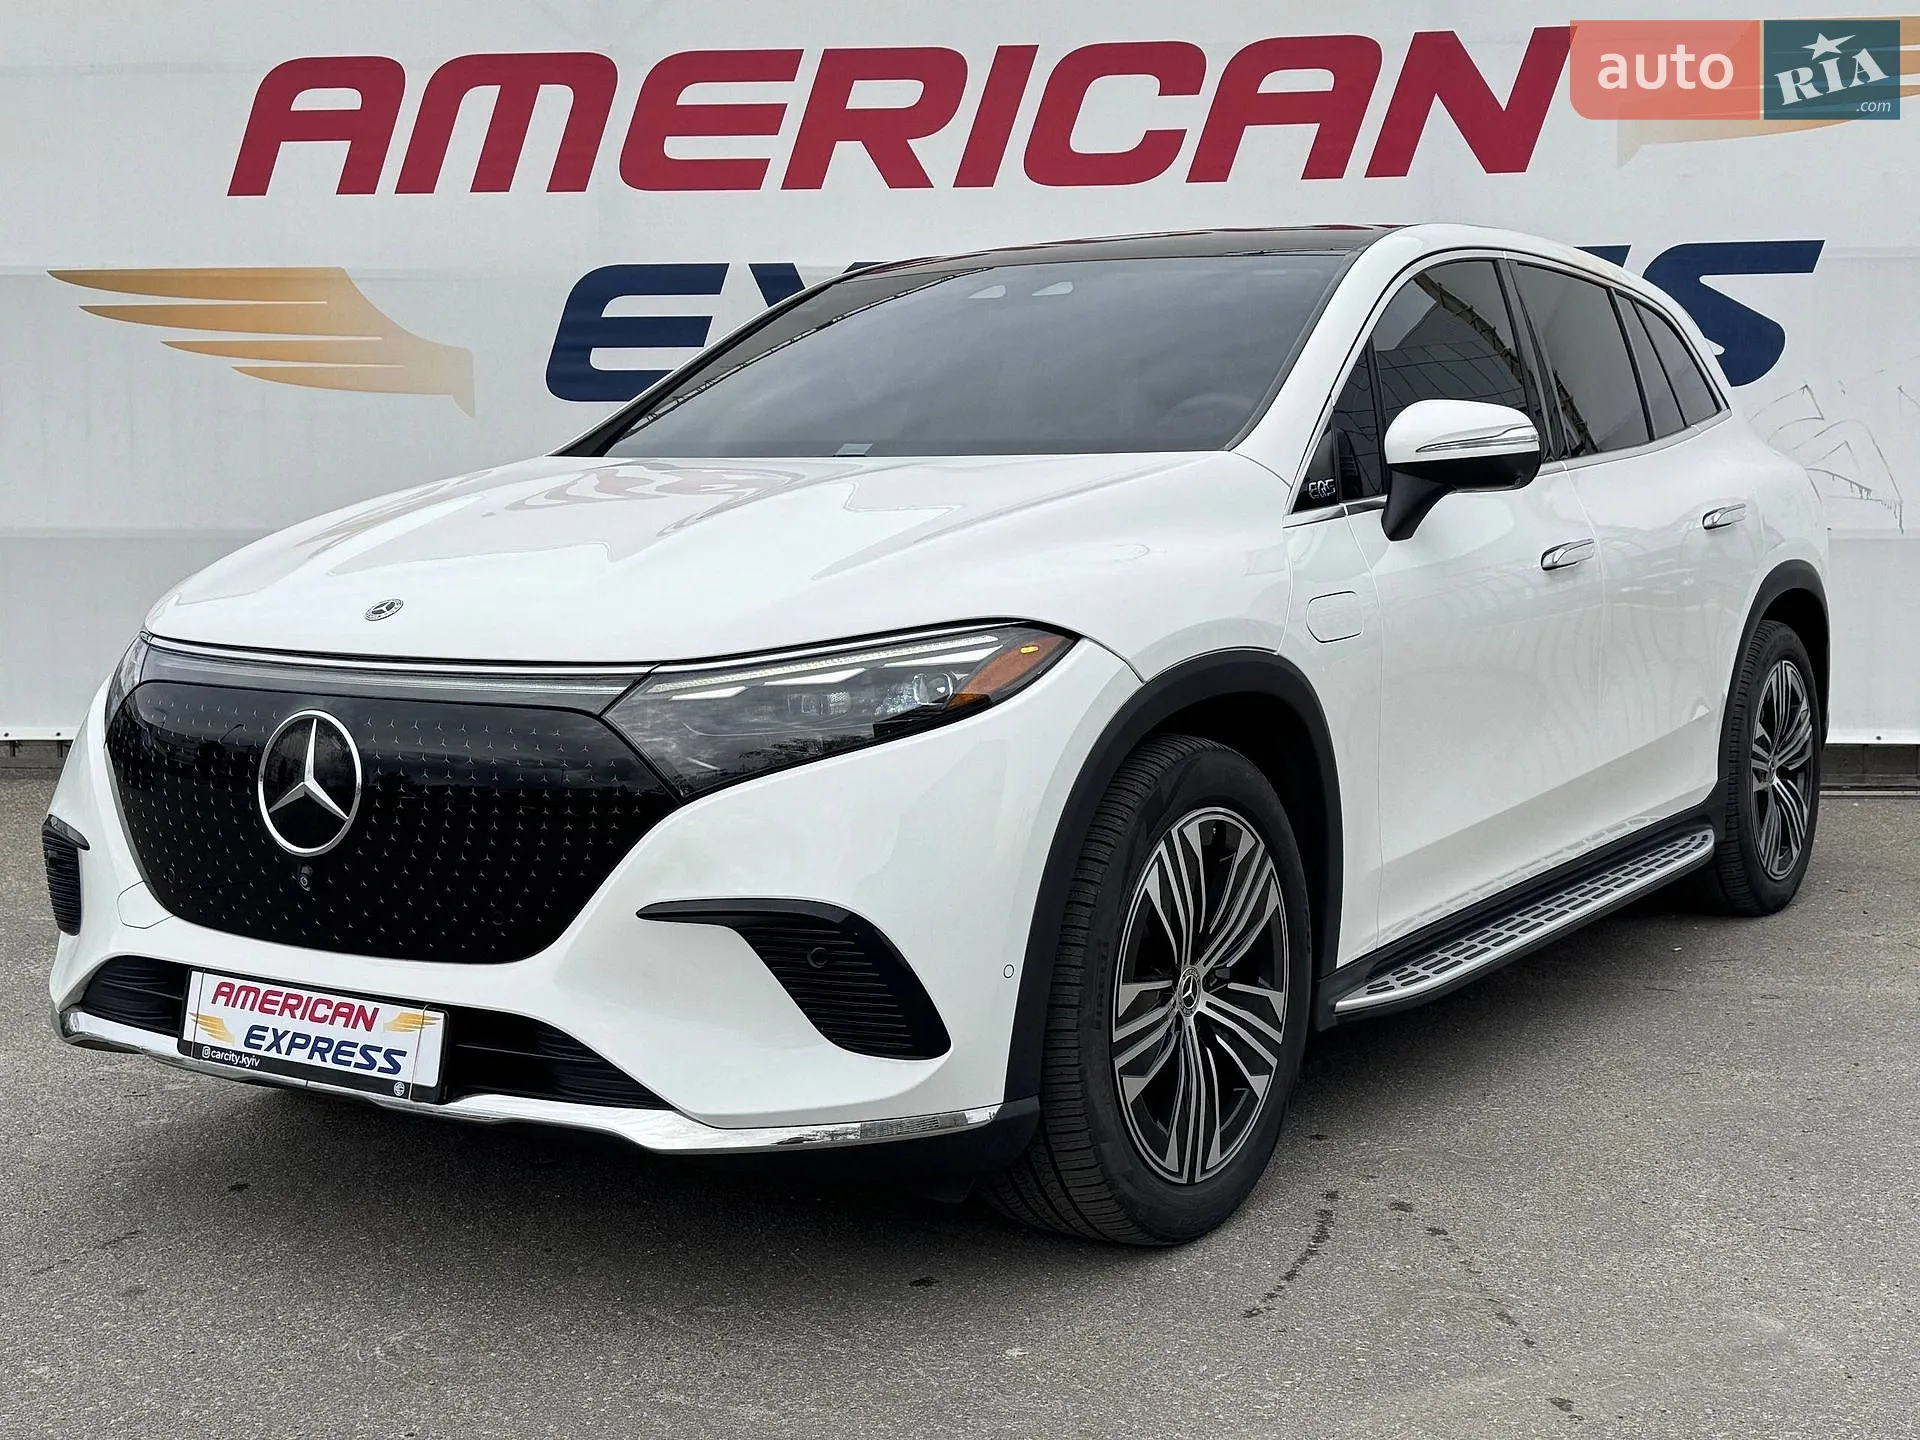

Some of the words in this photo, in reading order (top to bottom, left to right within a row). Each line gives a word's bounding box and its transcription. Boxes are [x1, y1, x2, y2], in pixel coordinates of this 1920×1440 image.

[229, 26, 1577, 197] AMERICAN
[1308, 478, 1336, 500] EQS
[211, 981, 380, 1032] AMERICAN
[244, 1024, 408, 1075] EXPRESS
